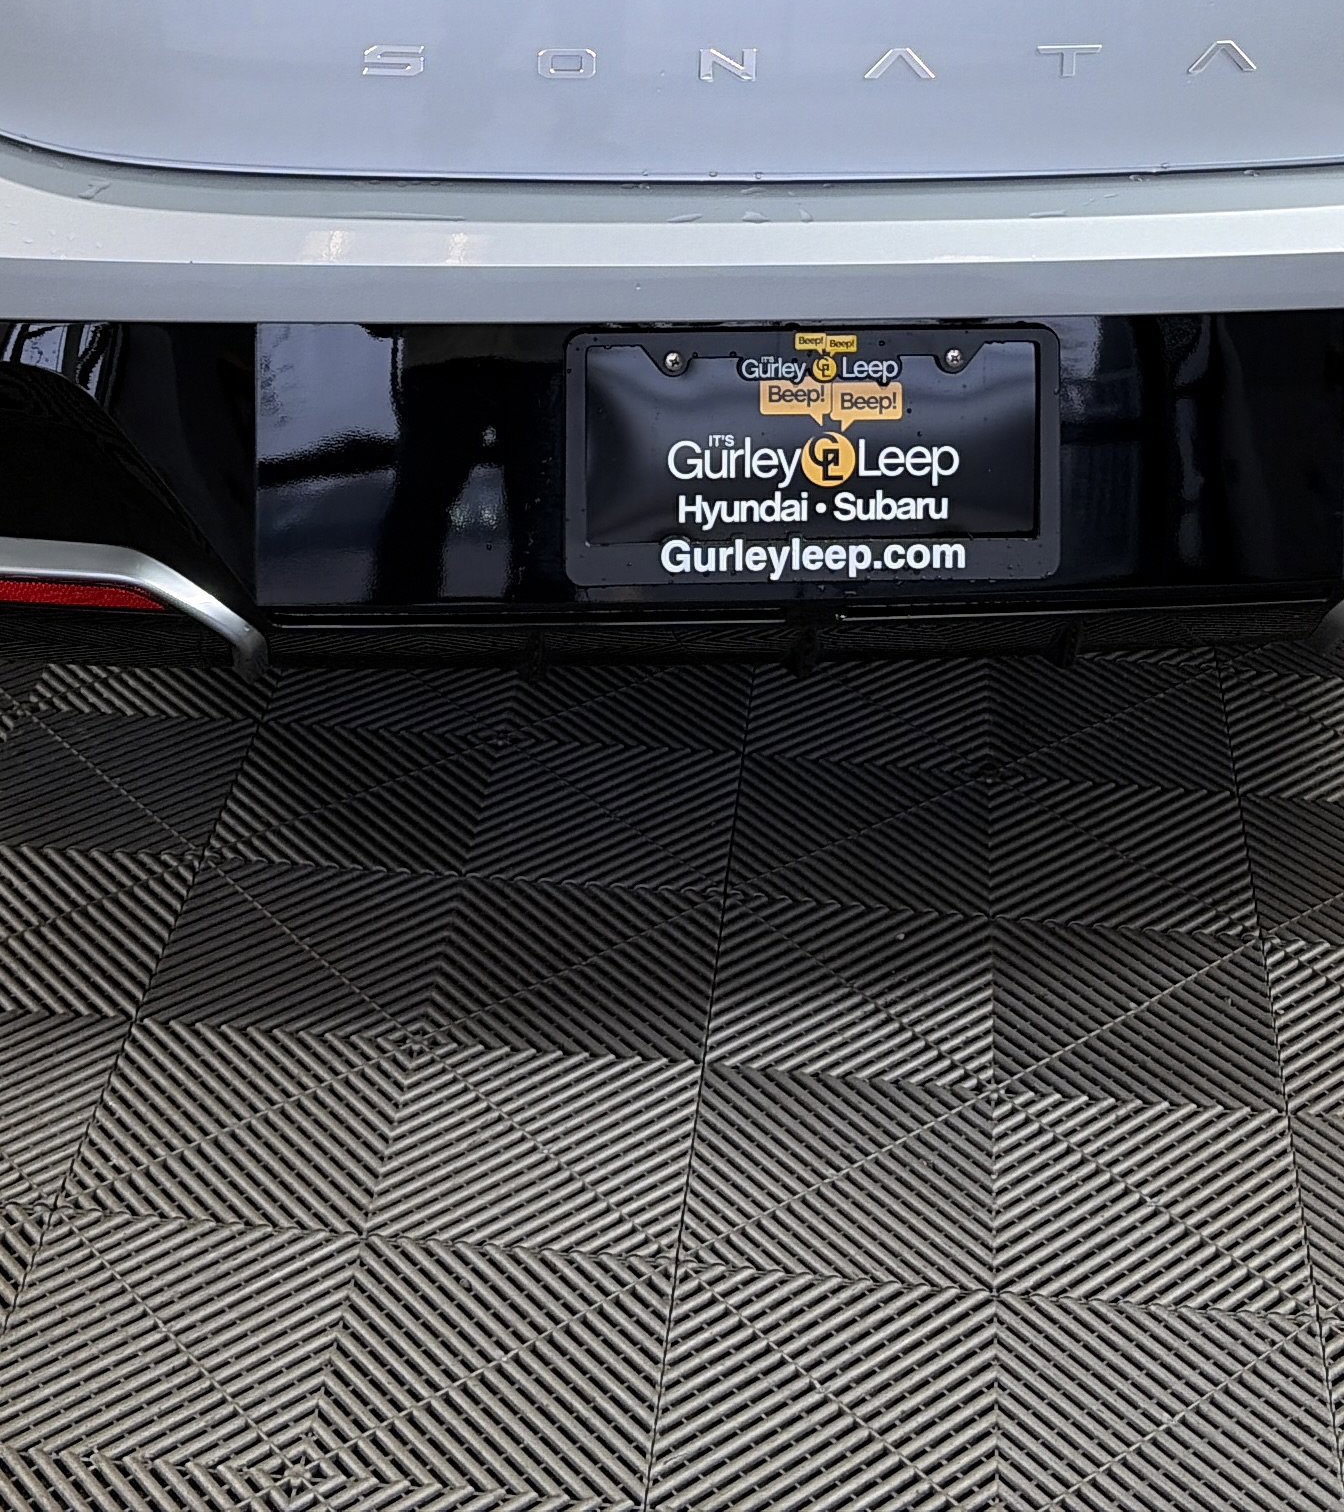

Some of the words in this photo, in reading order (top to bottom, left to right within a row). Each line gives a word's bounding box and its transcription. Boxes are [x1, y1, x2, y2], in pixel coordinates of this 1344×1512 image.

[798, 336, 824, 347] Beep!
[829, 339, 855, 349] Beep!
[741, 357, 806, 384] Gurley
[842, 356, 899, 384] Leep
[768, 385, 825, 408] Beep!
[840, 392, 897, 415] Beep!
[708, 434, 735, 447] IT'S
[667, 436, 801, 489] Gurley
[857, 438, 960, 487] Leep
[677, 491, 808, 531] Hyundai
[832, 489, 949, 522] Subaru
[660, 538, 967, 581] Gurleyleep.com
